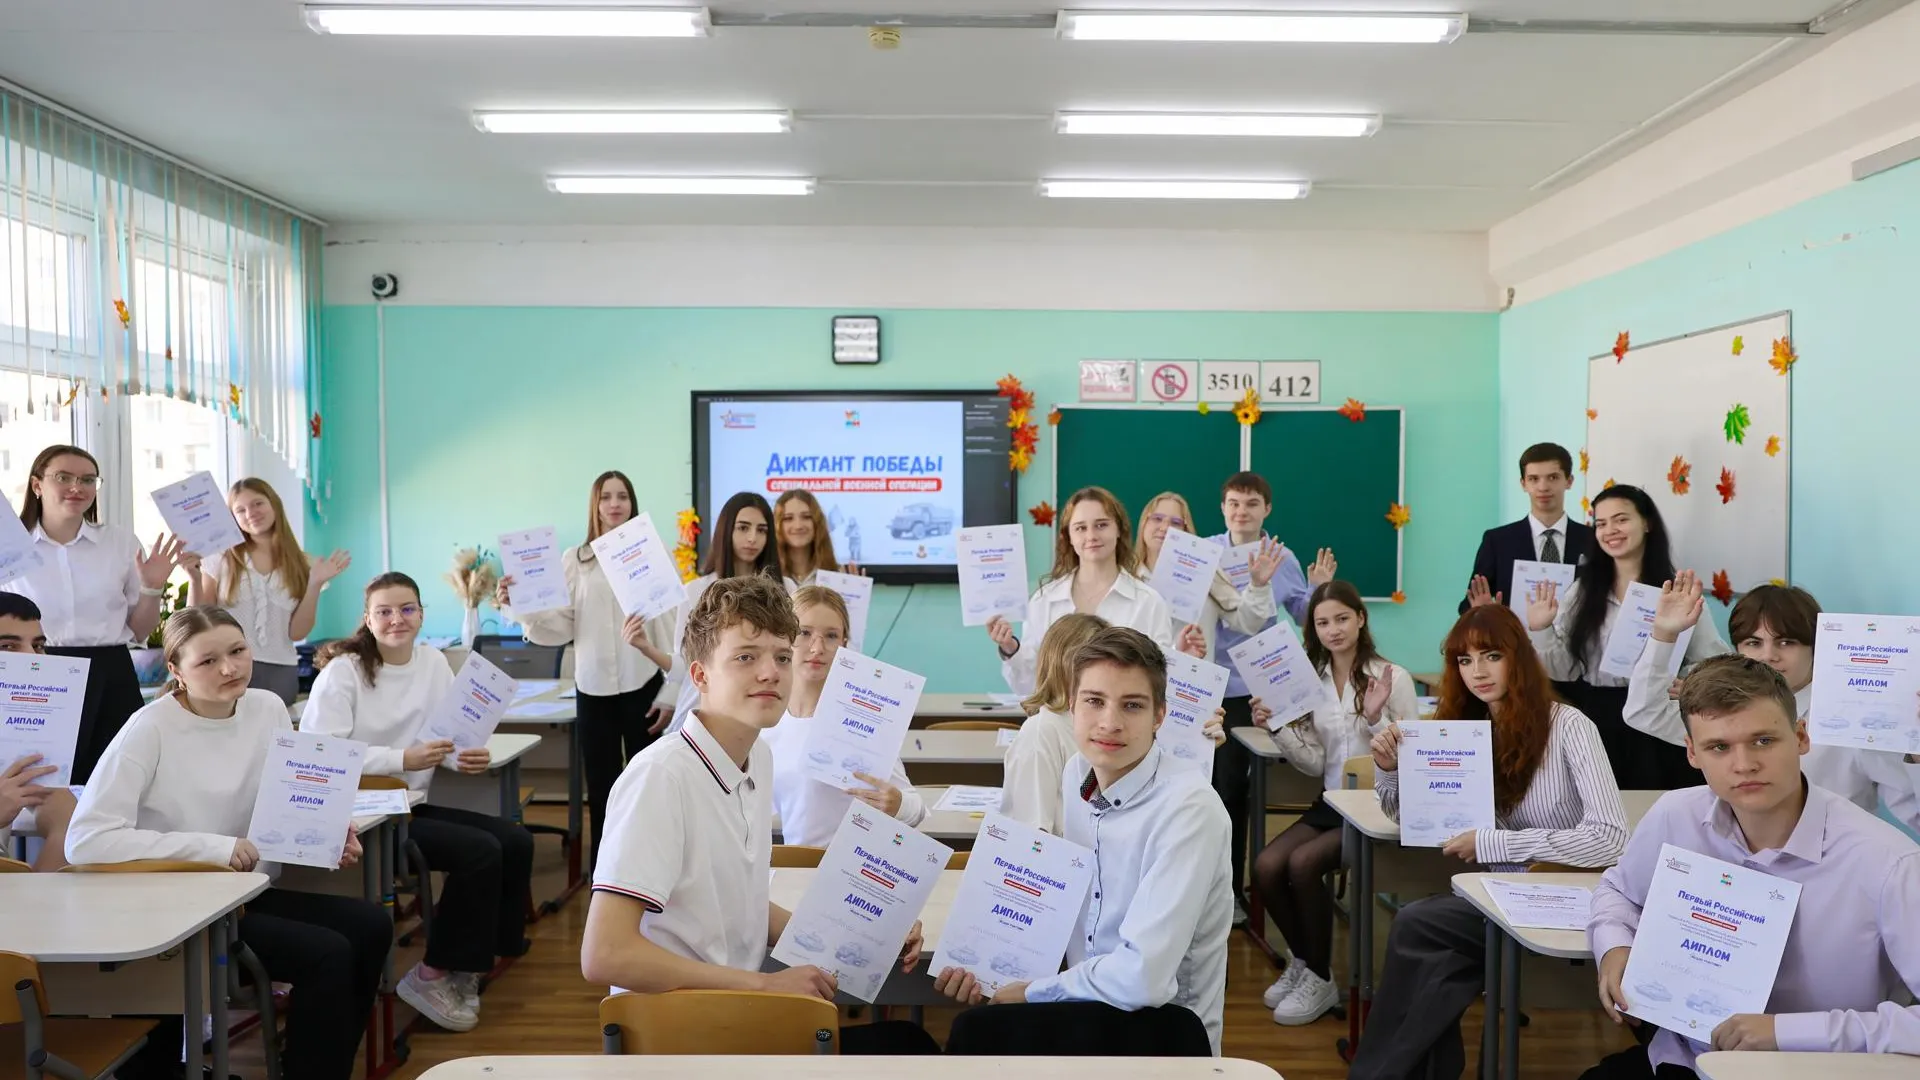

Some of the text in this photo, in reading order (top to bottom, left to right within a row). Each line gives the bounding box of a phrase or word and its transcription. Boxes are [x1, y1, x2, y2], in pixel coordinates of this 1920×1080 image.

[1208, 373, 1252, 390] 3510
[1269, 376, 1312, 397] 412
[1848, 677, 1888, 688] ДИПЛОМ
[5, 716, 45, 726] ДИПЛОМ
[841, 717, 875, 735] ДИПЛОМ
[1429, 781, 1462, 789] ДИПЛОМ
[289, 794, 324, 806] ДИПЛОМ
[844, 893, 883, 918] ДИПЛОМ
[991, 903, 1034, 926] ДИПЛОМ
[1680, 938, 1731, 963] ДИПЛОМ
